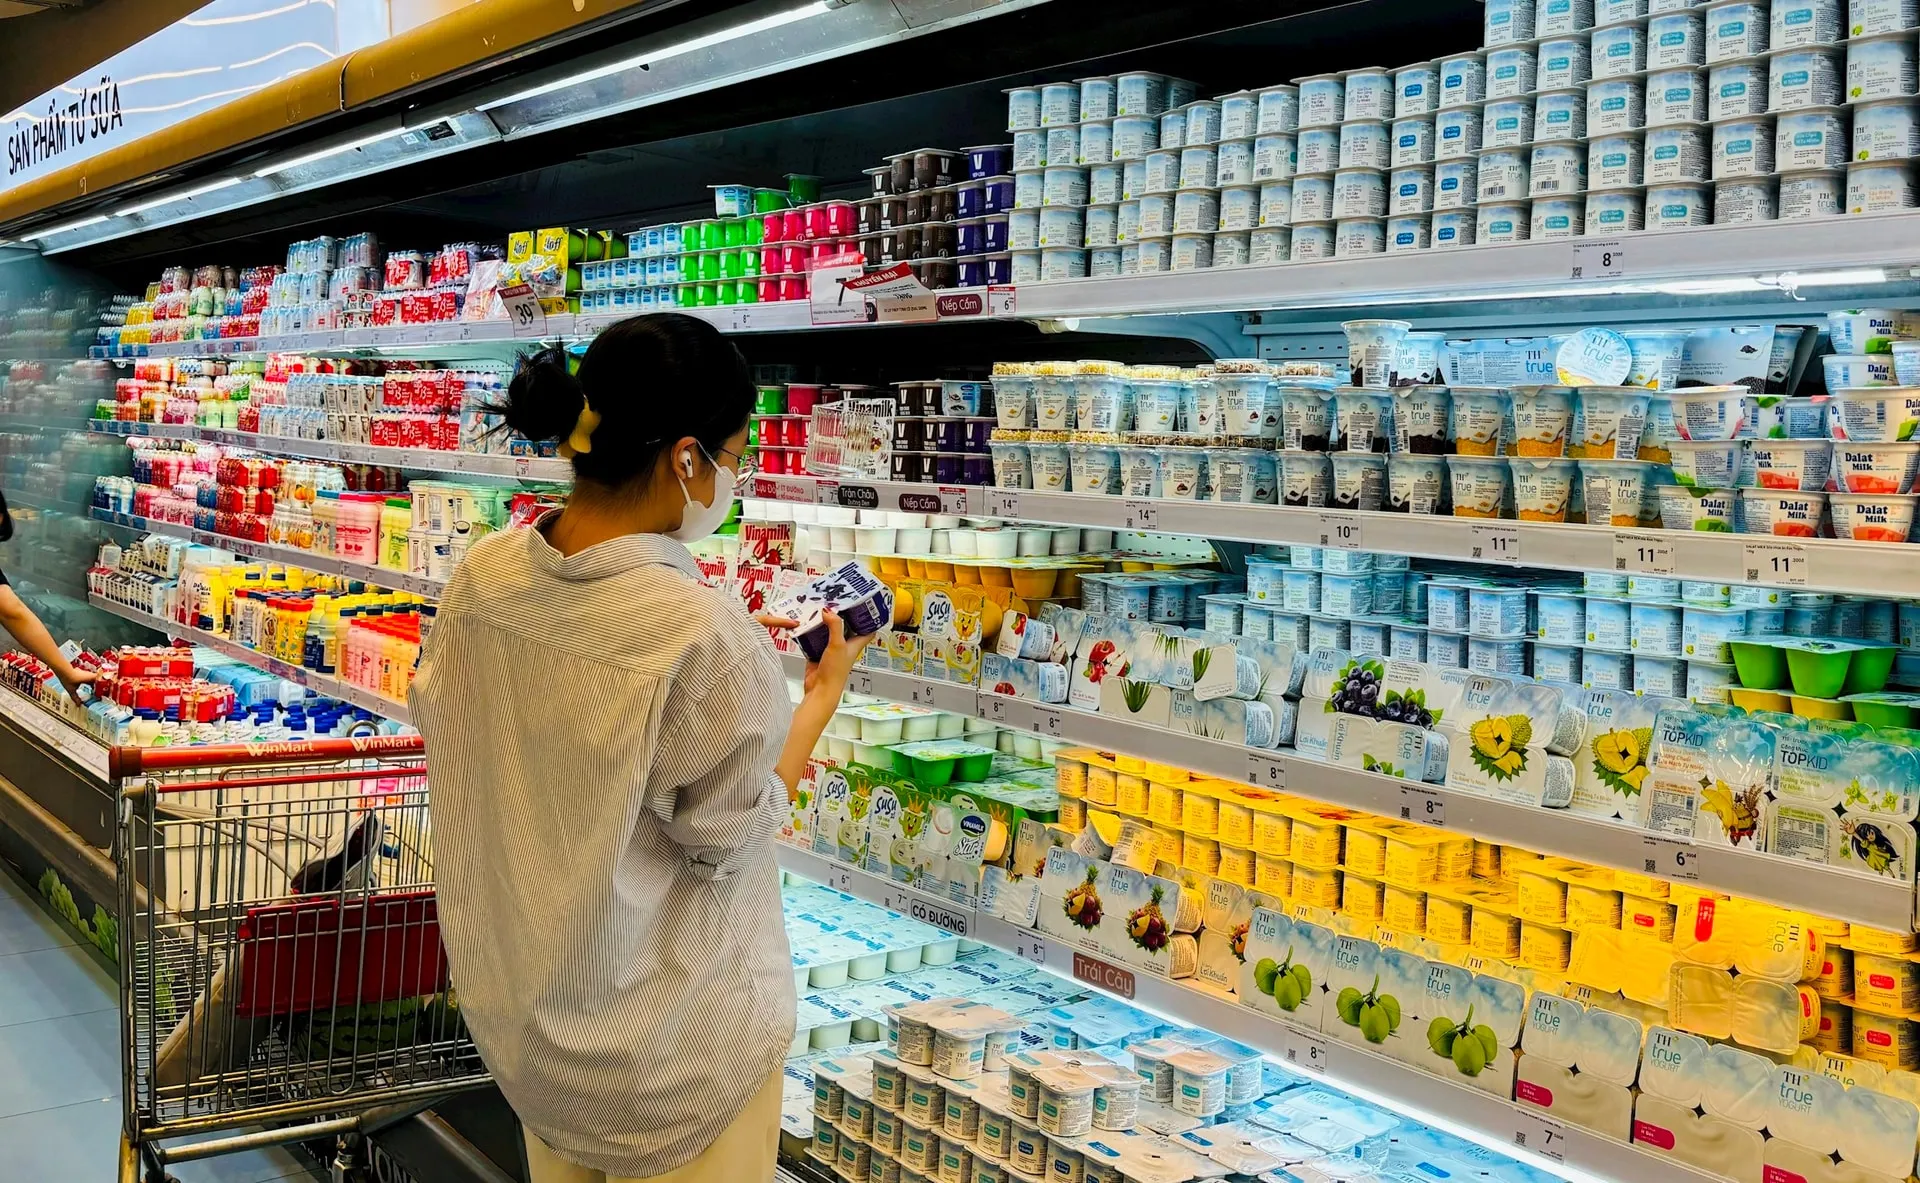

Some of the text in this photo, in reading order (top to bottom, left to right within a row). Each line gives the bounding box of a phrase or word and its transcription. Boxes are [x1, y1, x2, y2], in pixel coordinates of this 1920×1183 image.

[8, 75, 123, 176] SẢN PHẨM TỪ SỮA
[1602, 252, 1612, 267] 8
[852, 270, 898, 288] KHUYẾN MẠI
[835, 277, 847, 307] 7
[941, 299, 958, 313] Nếp
[1004, 300, 1010, 311] 6
[515, 303, 534, 325] 39
[1869, 319, 1893, 328] Dalat
[1591, 333, 1607, 348] TH
[1584, 345, 1614, 365] true
[1525, 361, 1553, 374] true
[1867, 364, 1889, 373] Dalat
[1140, 400, 1155, 409] true
[1227, 396, 1244, 406] true
[1306, 413, 1323, 423] true
[1410, 410, 1431, 420] true
[1516, 413, 1532, 421] true
[1845, 452, 1873, 462] Dalat
[1852, 463, 1873, 471] Milk
[1456, 482, 1471, 491] true
[1519, 484, 1537, 494] true
[1617, 488, 1638, 499] true
[903, 497, 919, 510] Nếp
[956, 499, 961, 510] 6
[1002, 499, 1012, 509] 14
[1700, 499, 1725, 510] Dalat
[1779, 500, 1808, 511] Dalat
[1856, 504, 1888, 515] Dalat
[1138, 509, 1150, 521] 14
[1707, 509, 1724, 517] Milk
[1787, 511, 1807, 520] Milk
[1865, 515, 1888, 523] Milk
[745, 524, 791, 541] Vinamilk
[1336, 525, 1351, 539] 10
[1491, 537, 1506, 551] 11
[1637, 547, 1655, 563] 11
[1770, 557, 1789, 573] 11
[737, 562, 774, 583] Vinamilk
[837, 561, 879, 597] Vinamilk
[1086, 623, 1103, 635] true
[984, 664, 999, 678] true
[1313, 660, 1334, 672] true
[926, 686, 931, 697] 6
[1467, 691, 1490, 705] true
[993, 702, 999, 713] 8
[1174, 701, 1193, 714] true
[1587, 701, 1613, 718] true
[1048, 717, 1055, 729] 8
[245, 734, 416, 757] WinMart WinMart
[1403, 731, 1414, 760] true
[1662, 729, 1704, 748] TOPKID
[1780, 749, 1828, 771] TOPKID
[1270, 766, 1278, 780] 8
[1426, 800, 1435, 814] 8
[962, 819, 985, 833] VINAMILK
[1019, 831, 1035, 843] true
[1052, 850, 1063, 860] TH
[1676, 852, 1686, 867] 6
[1050, 858, 1067, 872] true
[1113, 868, 1124, 879] TH
[1111, 877, 1129, 893] true
[1210, 891, 1229, 907] true
[912, 904, 966, 934] CÓ ĐƯỜNG
[1258, 911, 1270, 923] TH
[1255, 920, 1276, 938] true
[1772, 920, 1790, 953] true
[1033, 944, 1038, 954] 8
[1339, 938, 1353, 951] TH
[1336, 947, 1360, 965] true
[1075, 957, 1134, 996] Trái Cây
[1429, 966, 1443, 979] TH
[1426, 976, 1451, 994] true
[1577, 986, 1591, 999] TH
[1537, 997, 1552, 1012] TH
[1533, 1008, 1561, 1028] true
[1532, 1021, 1559, 1036] YOGURT
[1655, 1032, 1671, 1047] TH
[1310, 1046, 1317, 1059] 8
[1651, 1045, 1682, 1065] true
[1650, 1060, 1681, 1073] YOGURT
[1826, 1057, 1845, 1073] TH
[1783, 1070, 1801, 1087] TH
[1823, 1068, 1856, 1086] true
[1779, 1081, 1813, 1106] true
[1778, 1096, 1812, 1115] YOGURT
[1544, 1129, 1553, 1144] 7
